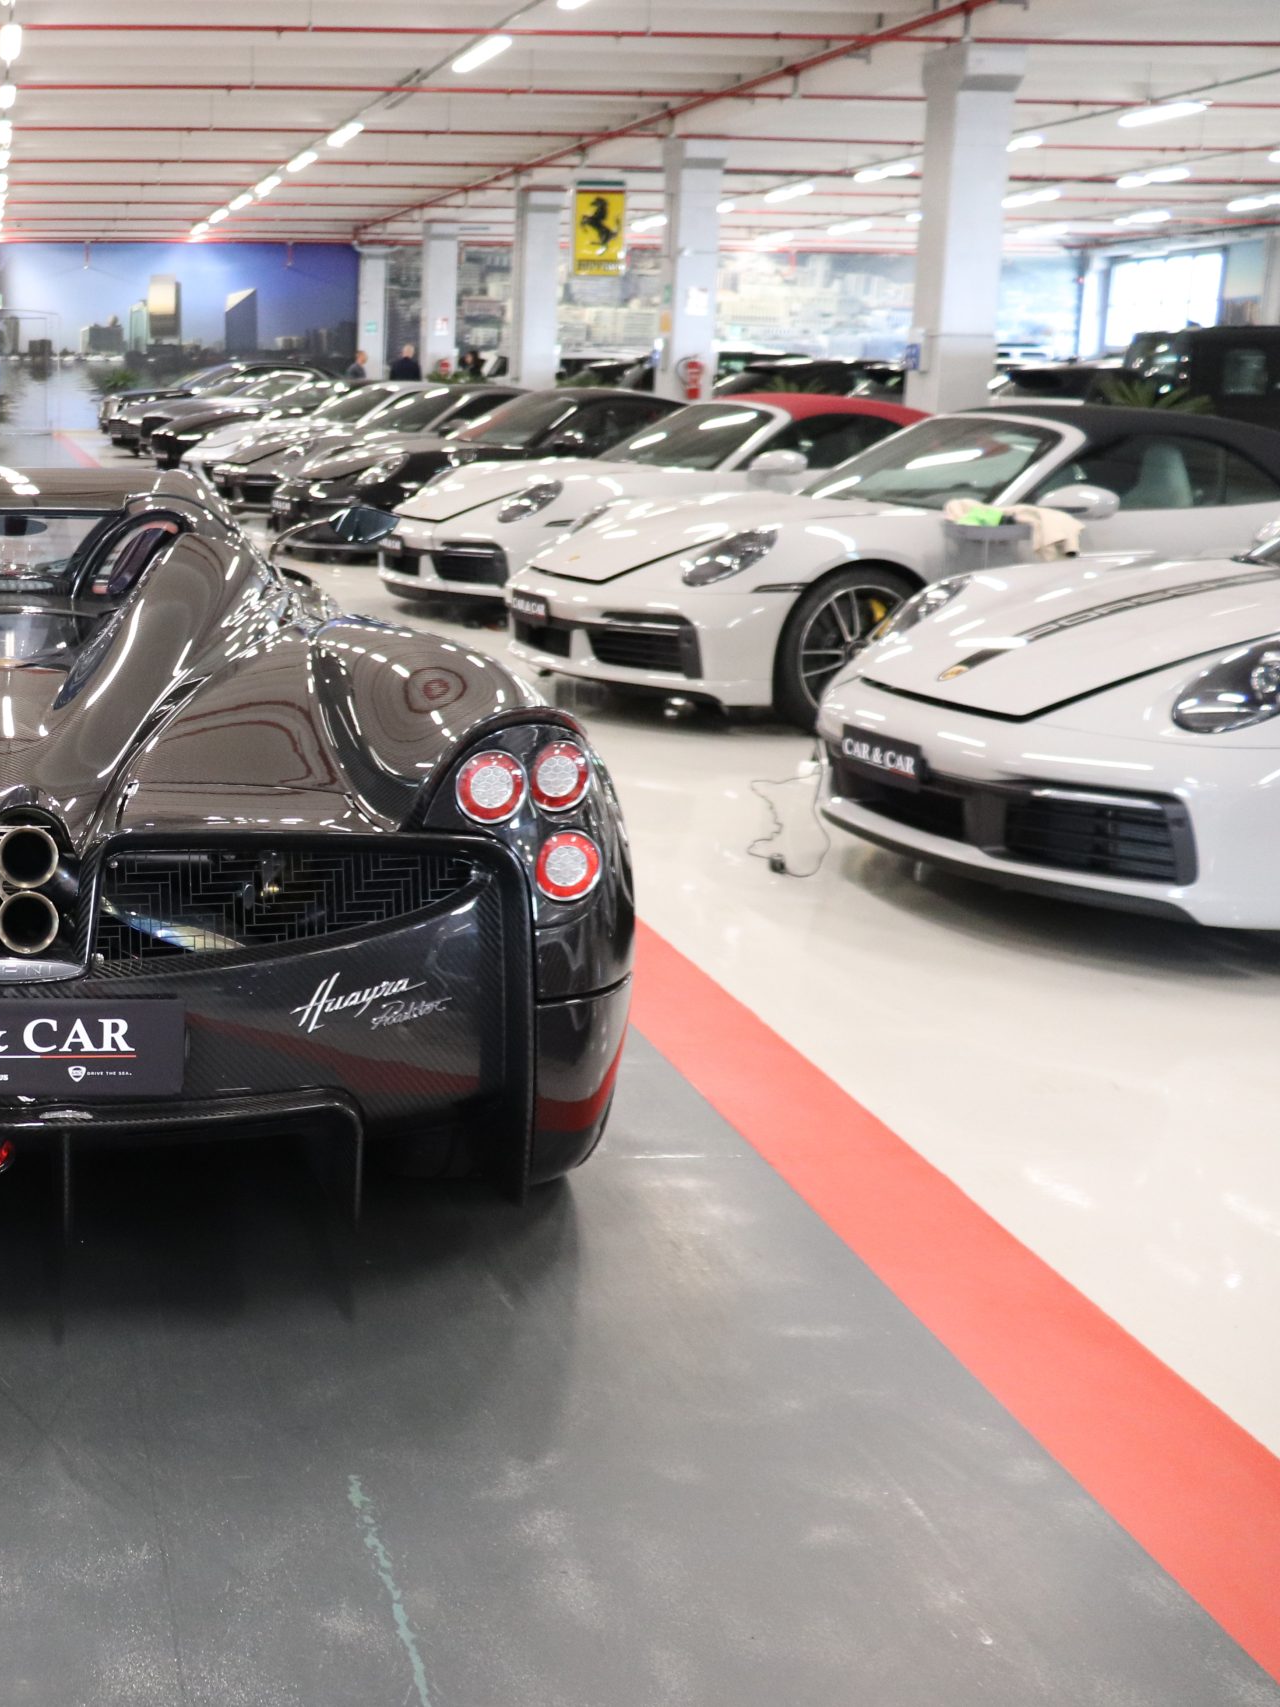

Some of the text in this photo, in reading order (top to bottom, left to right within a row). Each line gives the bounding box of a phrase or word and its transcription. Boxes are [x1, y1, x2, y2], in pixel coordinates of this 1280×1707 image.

[842, 738, 916, 775] CAR & CAR
[290, 972, 428, 1034] Huayra
[23, 1018, 136, 1053] CAR
